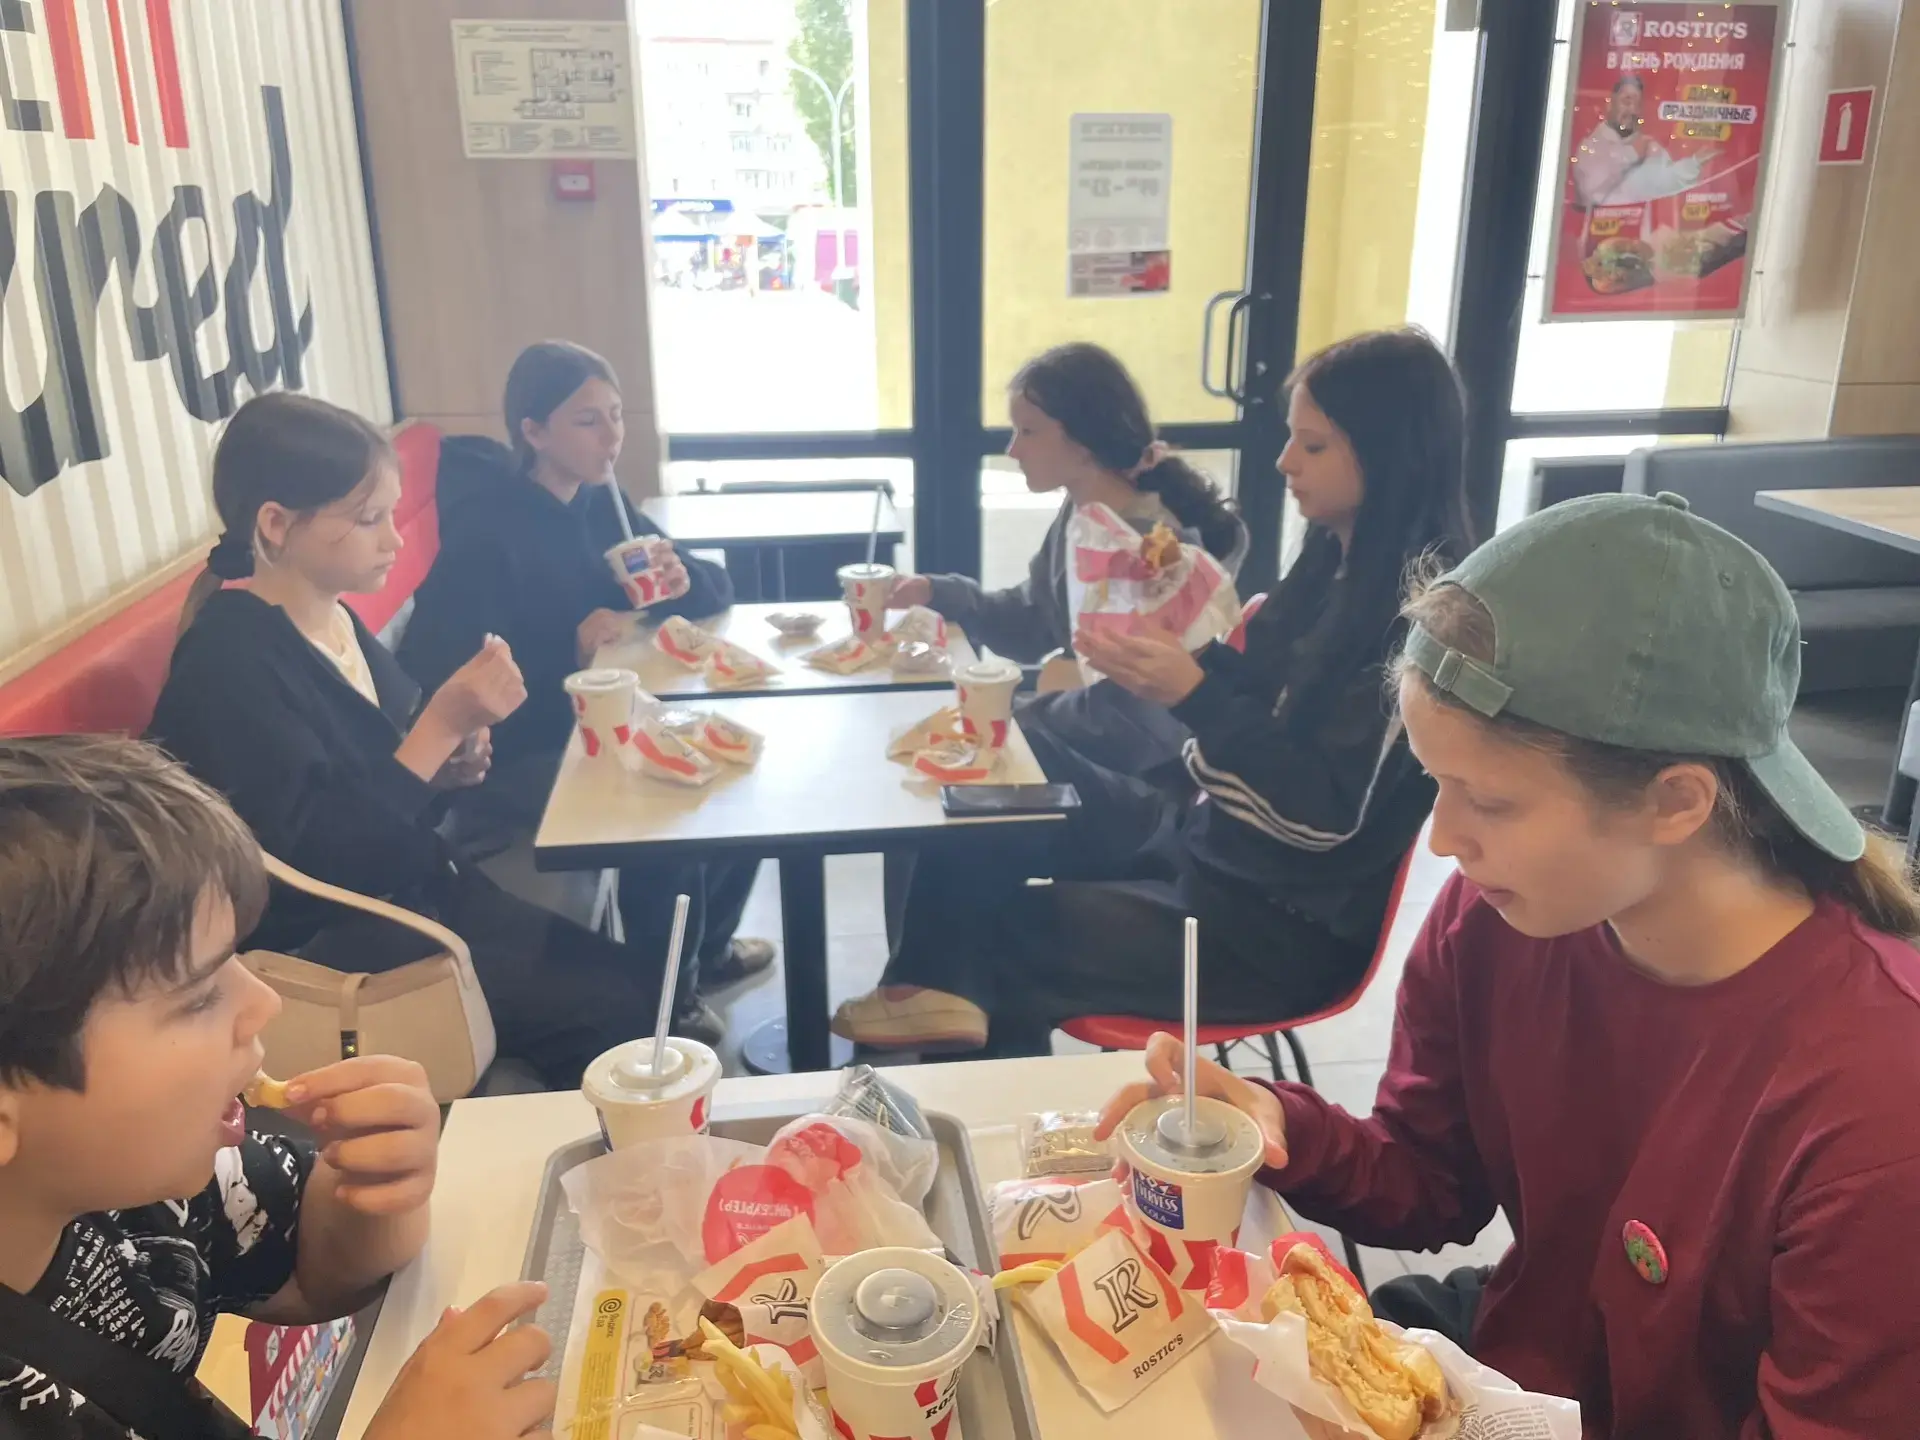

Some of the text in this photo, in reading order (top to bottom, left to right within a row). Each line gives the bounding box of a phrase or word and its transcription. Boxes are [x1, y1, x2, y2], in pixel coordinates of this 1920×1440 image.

[1643, 20, 1748, 39] ROSTIC'S
[1606, 51, 1746, 71] В ДЕНЬ РОЖДЕНИЯ
[1662, 103, 1753, 122] ПРАЗДНИЧНЫЕ
[1135, 1178, 1178, 1212] EVERVESS
[1093, 1257, 1159, 1334] R
[1132, 1333, 1185, 1379] ROSTIC'S
